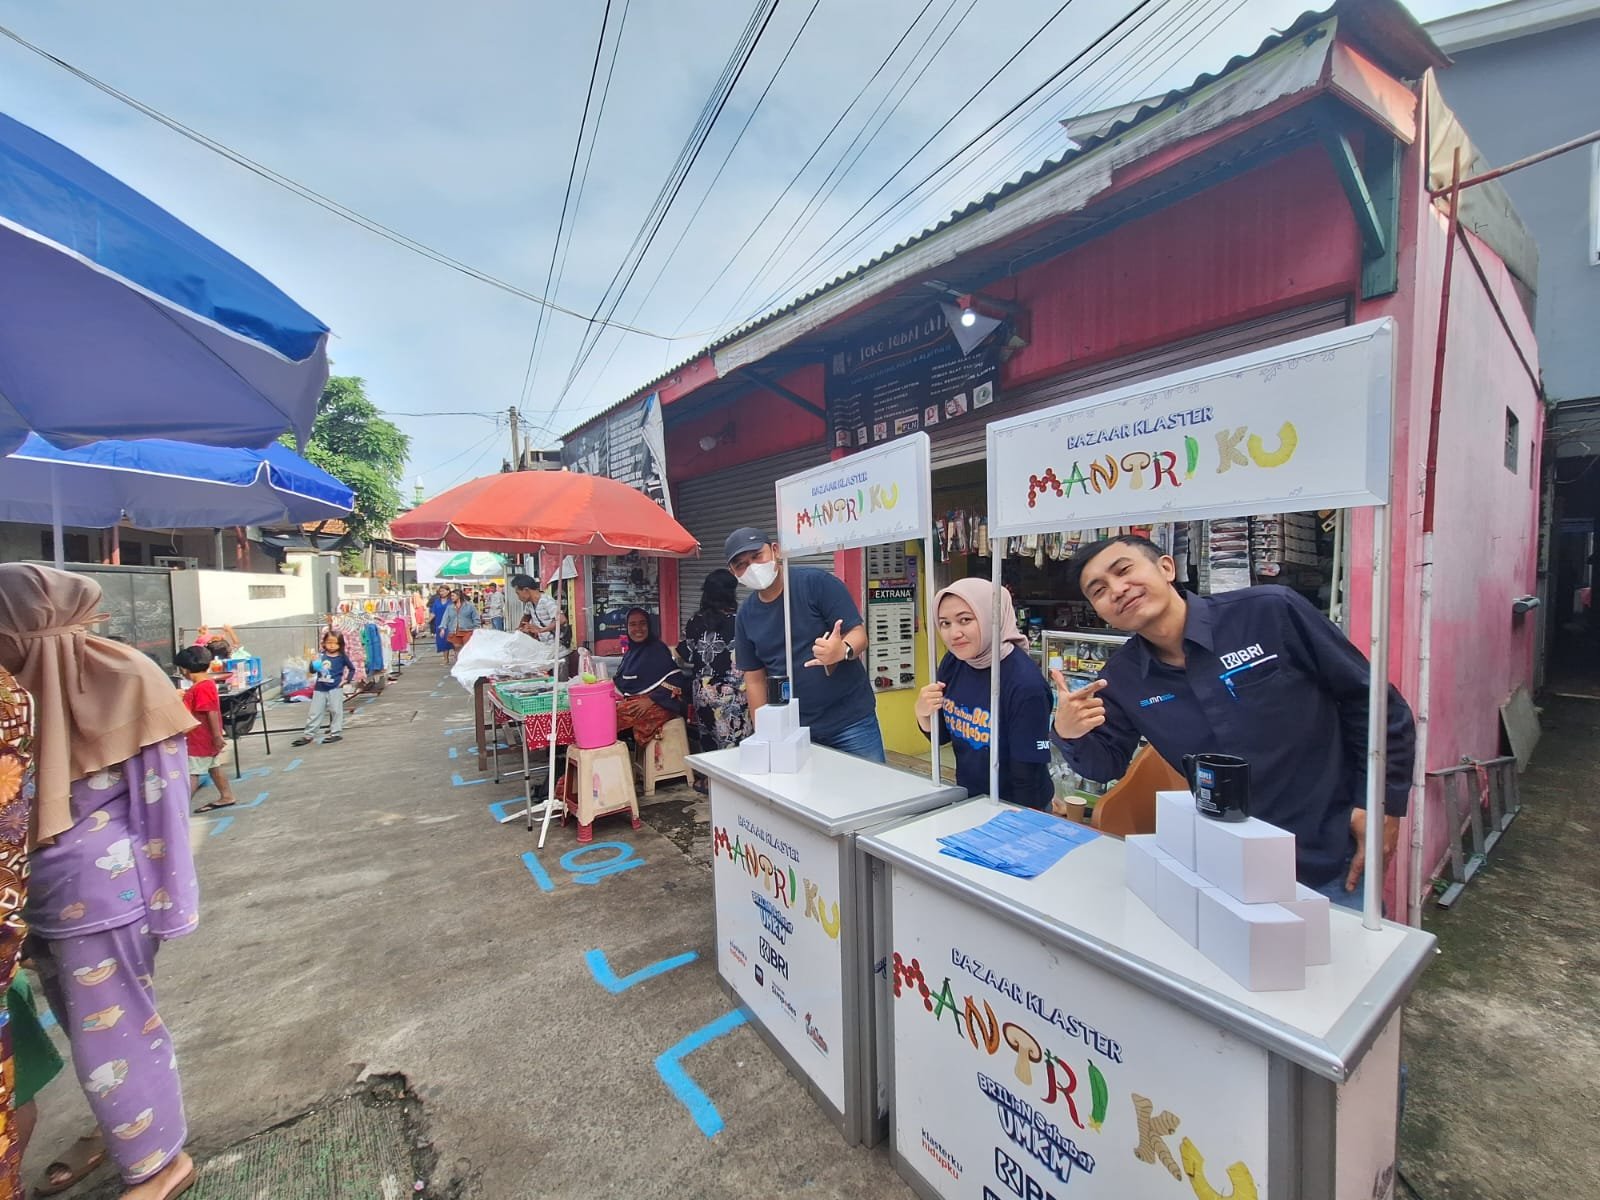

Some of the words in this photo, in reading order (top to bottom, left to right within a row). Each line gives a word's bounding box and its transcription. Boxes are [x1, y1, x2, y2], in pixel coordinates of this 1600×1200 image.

[1067, 422, 1130, 449] BAZAAR
[1132, 405, 1214, 436] KLASTER
[811, 483, 838, 496] BAZAAR
[838, 471, 868, 491] KLASTER
[1027, 434, 1199, 509] MANTRI
[1214, 419, 1298, 475] KU
[796, 488, 865, 535] MANTRI
[869, 481, 899, 514] KU
[875, 589, 911, 599] EXTRANA
[1238, 643, 1265, 662] BRI
[962, 720, 991, 743] Heba
[972, 707, 992, 728] BR
[738, 814, 765, 843] BAZAAR
[765, 829, 800, 863] KLASTER
[713, 826, 797, 909] MANTRI
[802, 877, 841, 939] KU
[770, 948, 788, 981] BRI
[950, 947, 1023, 1004] BAZAAR
[1025, 990, 1124, 1065] KLASTER
[893, 951, 1110, 1133] MANTRI
[1131, 1091, 1259, 1200] KU
[921, 1127, 964, 1173] klasterku
[921, 1139, 959, 1181] hidupku
[998, 1104, 1073, 1184] UMKM
[1033, 1111, 1096, 1174] Sahabat
